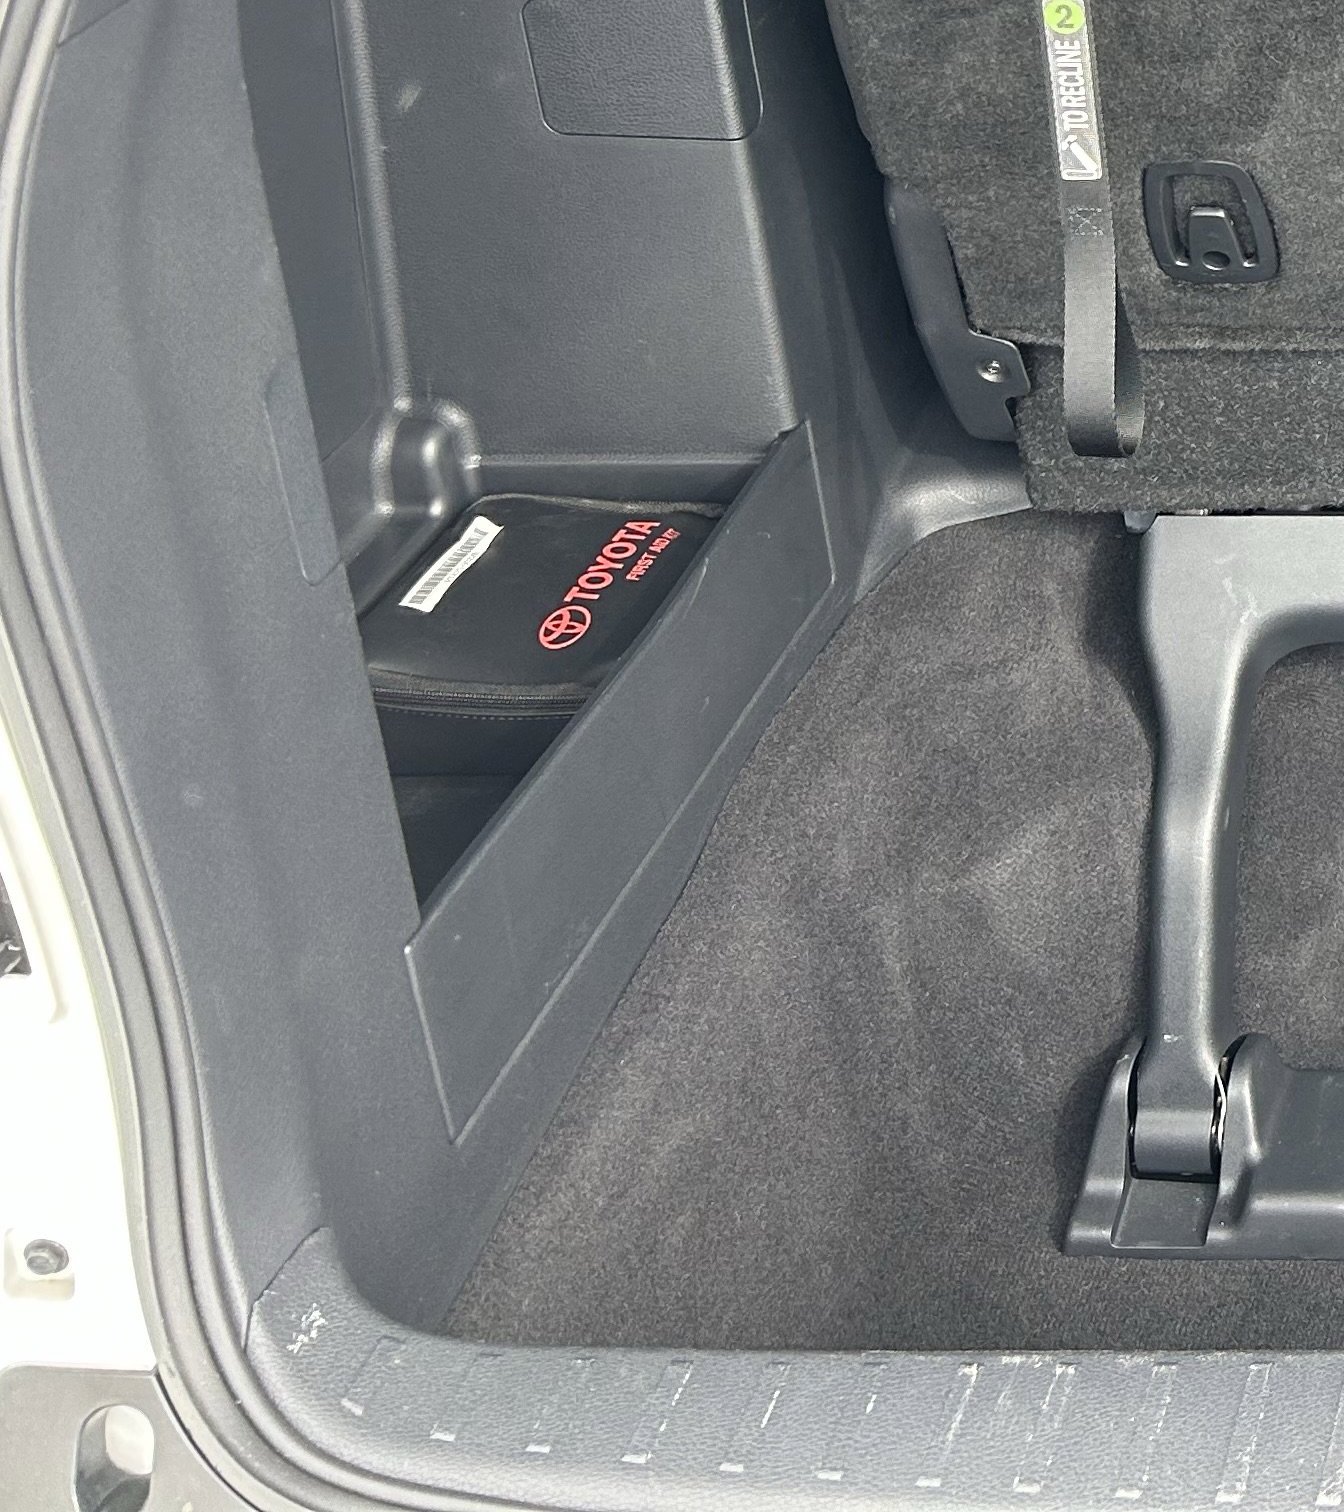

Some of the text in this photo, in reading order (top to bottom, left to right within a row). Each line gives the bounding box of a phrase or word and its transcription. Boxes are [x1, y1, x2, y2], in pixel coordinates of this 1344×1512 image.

[1055, 4, 1075, 29] 2
[1054, 39, 1089, 132] TO RECLINE
[564, 521, 661, 603] TOYOTA
[625, 552, 657, 581] FIRST
[648, 537, 671, 553] AID
